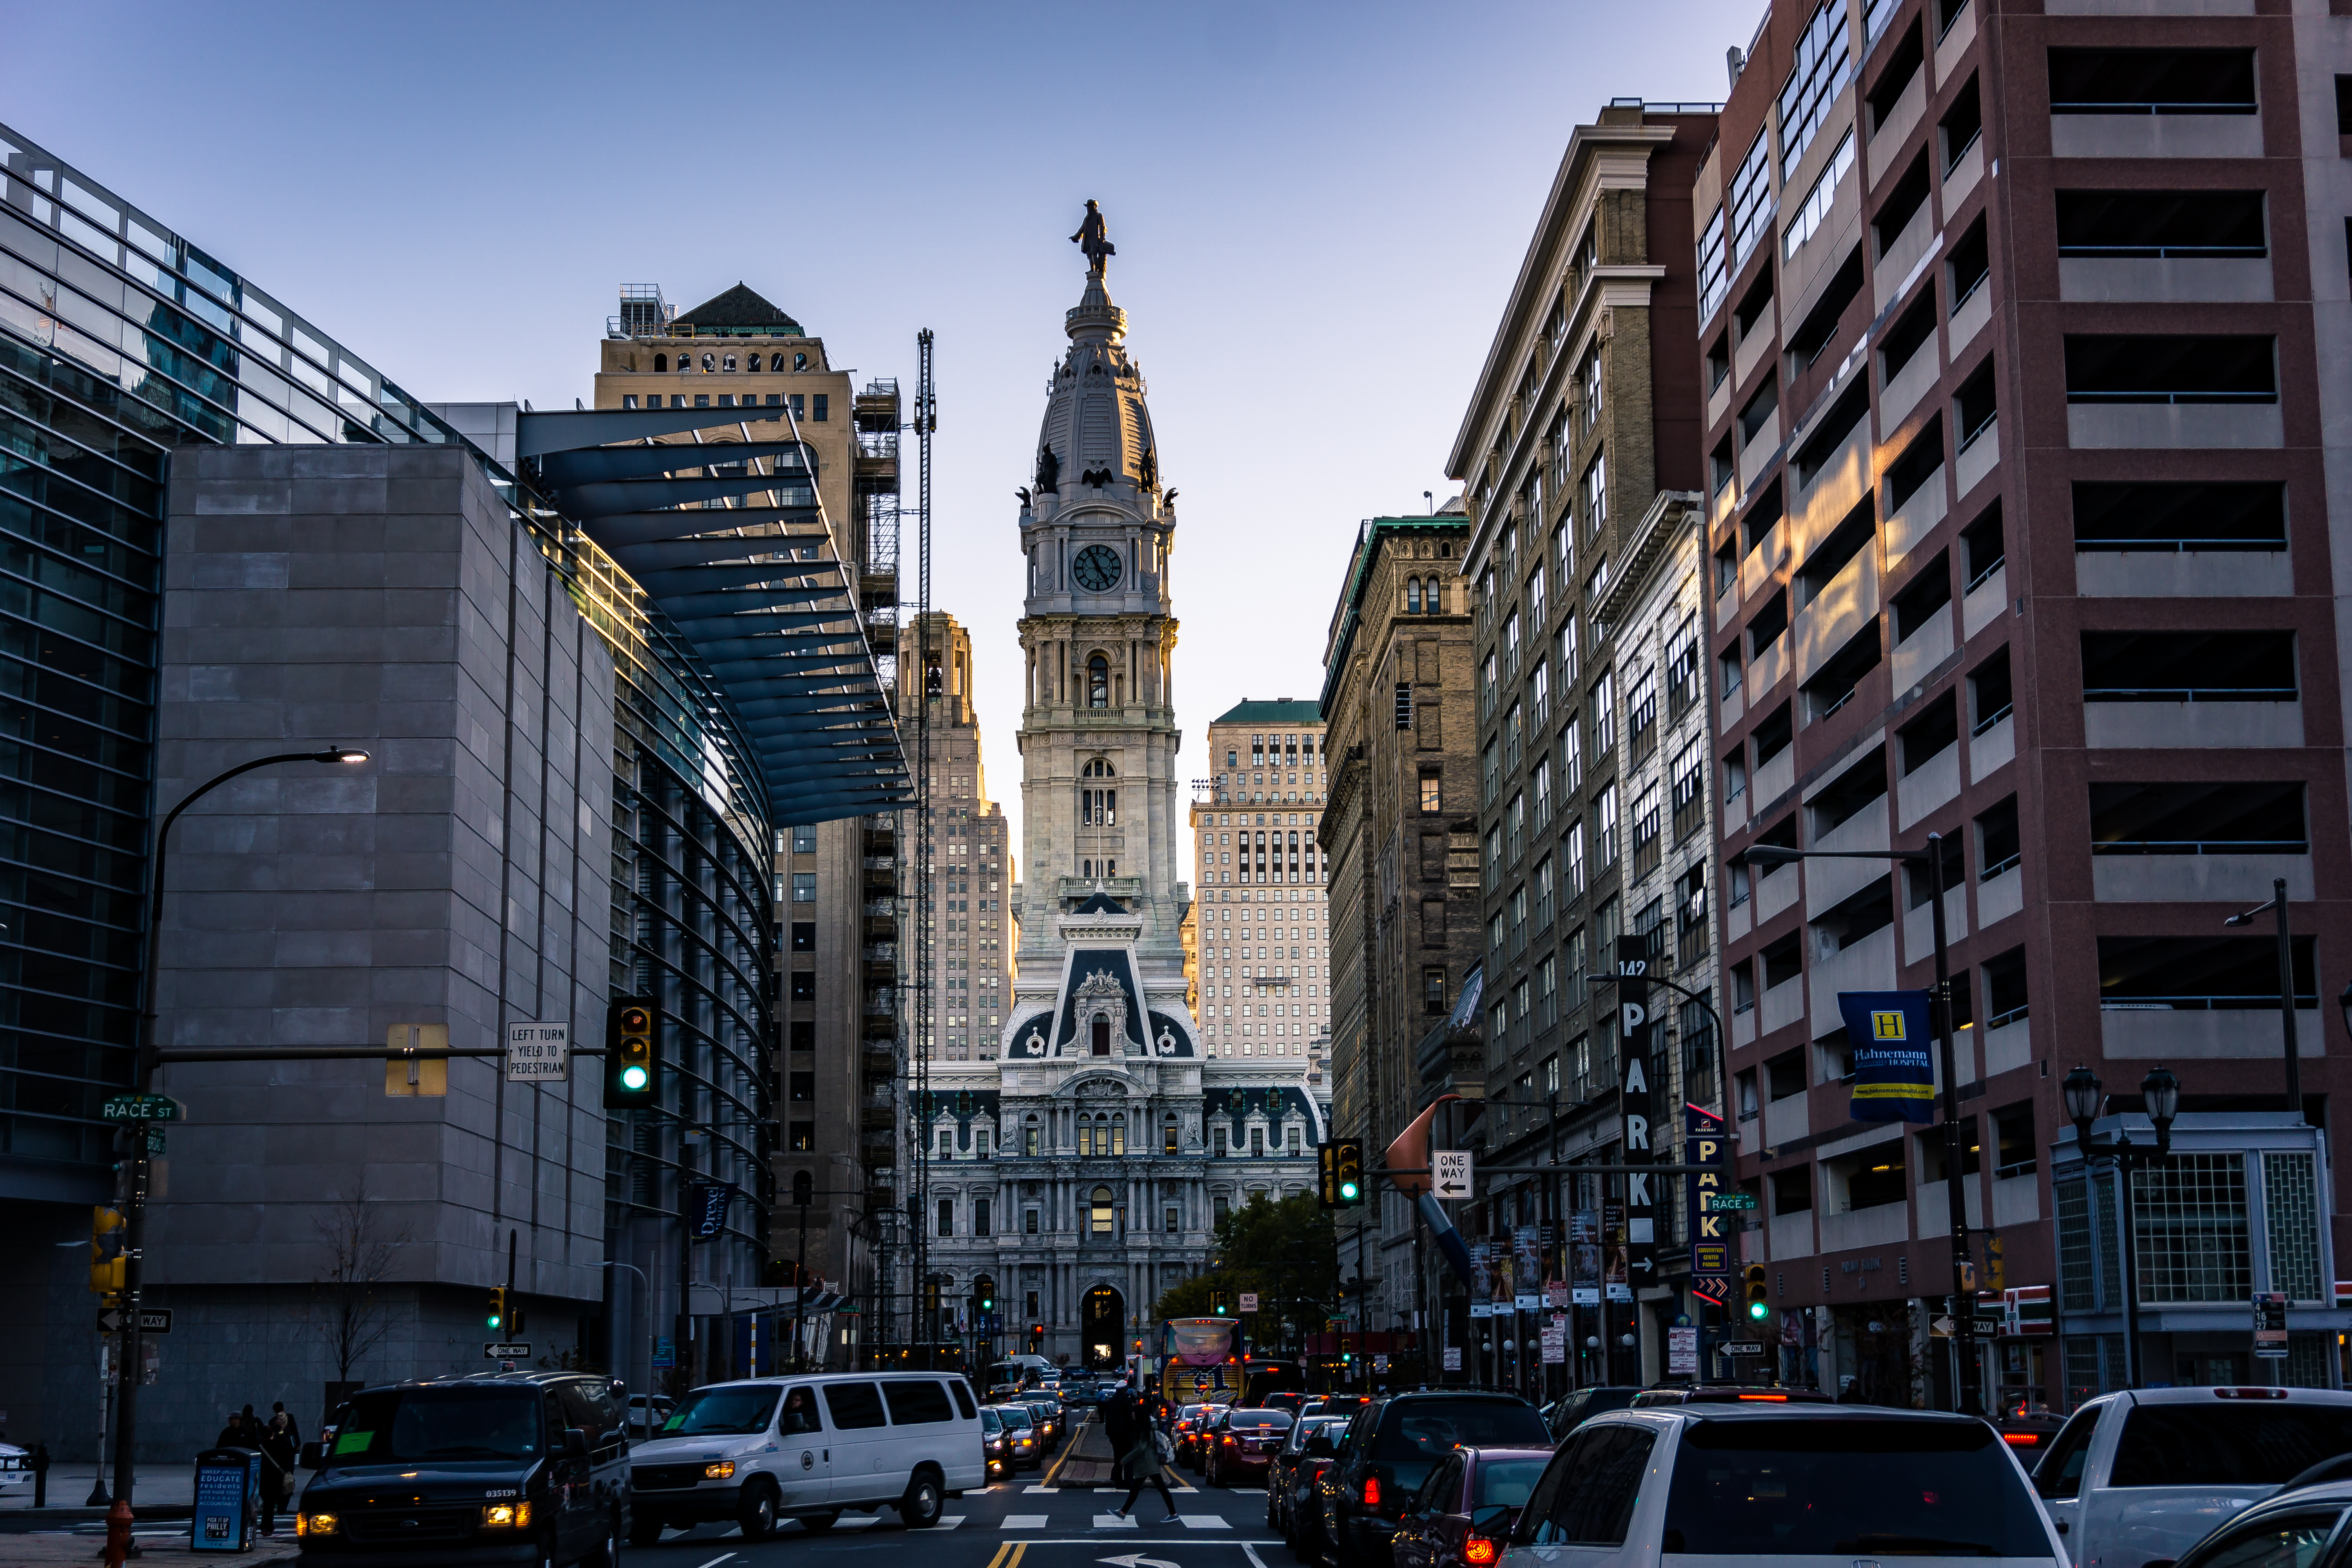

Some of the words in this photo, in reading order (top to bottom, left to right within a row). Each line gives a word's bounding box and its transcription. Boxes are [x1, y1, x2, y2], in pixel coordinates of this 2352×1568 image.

[1619, 960, 1646, 976] 142
[1876, 1015, 1902, 1036] H
[512, 1029, 535, 1040] LEFT
[539, 1029, 564, 1040] TURN
[518, 1046, 543, 1057] YIELD
[547, 1045, 557, 1056] TO
[1854, 1049, 1927, 1060] Hahnemann
[511, 1062, 564, 1073] PEDESTRIAN
[1623, 1003, 1651, 1205] PARK
[104, 1104, 151, 1116] RACE
[158, 1108, 171, 1116] ST
[1441, 1156, 1465, 1166] ONE
[1440, 1168, 1465, 1178] WAY
[1713, 1200, 1742, 1209] RACE
[701, 1186, 719, 1235] Drexel
[143, 1317, 163, 1325] WAY
[2256, 1312, 2267, 1321] 16
[1973, 1322, 1991, 1331] WAY
[2256, 1322, 2266, 1330] 27
